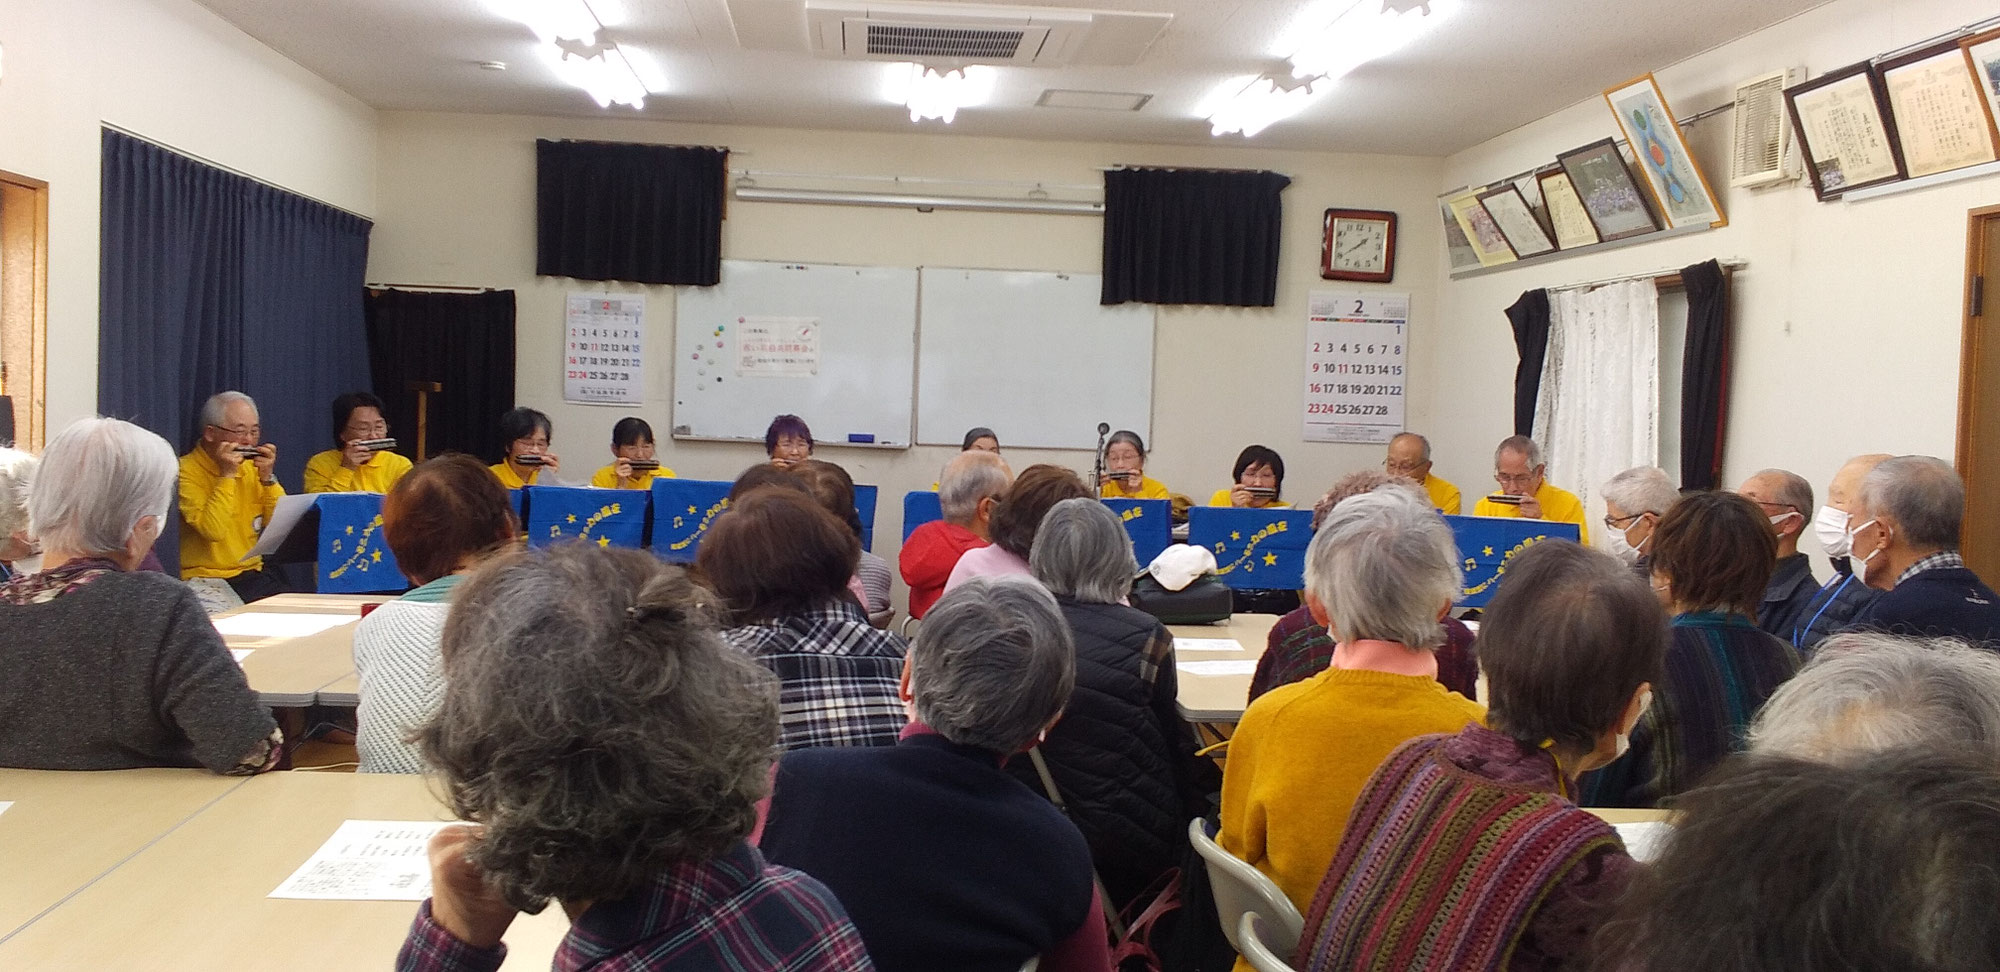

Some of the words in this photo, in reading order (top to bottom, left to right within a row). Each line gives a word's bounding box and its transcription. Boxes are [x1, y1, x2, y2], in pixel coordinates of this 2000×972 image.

[1354, 300, 1363, 314] 2
[1396, 325, 1400, 334] 1
[1314, 343, 1320, 352] 2
[1327, 343, 1333, 352] 3
[1340, 344, 1347, 352] 4
[1354, 344, 1360, 353] 5
[1368, 345, 1374, 354] 6
[1381, 345, 1387, 354] 7
[1394, 346, 1400, 355] 8
[1313, 363, 1319, 372] 9
[1324, 364, 1335, 372] 10
[1339, 364, 1348, 373] 11
[1352, 364, 1362, 374] 12
[1365, 365, 1375, 374] 13
[1378, 366, 1388, 374] 14
[1392, 366, 1402, 375] 15
[1310, 384, 1320, 393] 16
[1323, 384, 1334, 393] 17
[1337, 384, 1347, 393] 18
[1351, 385, 1360, 394] 19
[1363, 385, 1375, 394] 20
[1377, 386, 1388, 395] 21
[1390, 386, 1402, 395] 22
[1308, 404, 1320, 413] 23
[1322, 404, 1333, 413] 24
[1335, 404, 1347, 414] 25
[1349, 405, 1360, 414] 26
[1362, 406, 1374, 414] 27
[1376, 406, 1388, 415] 28
